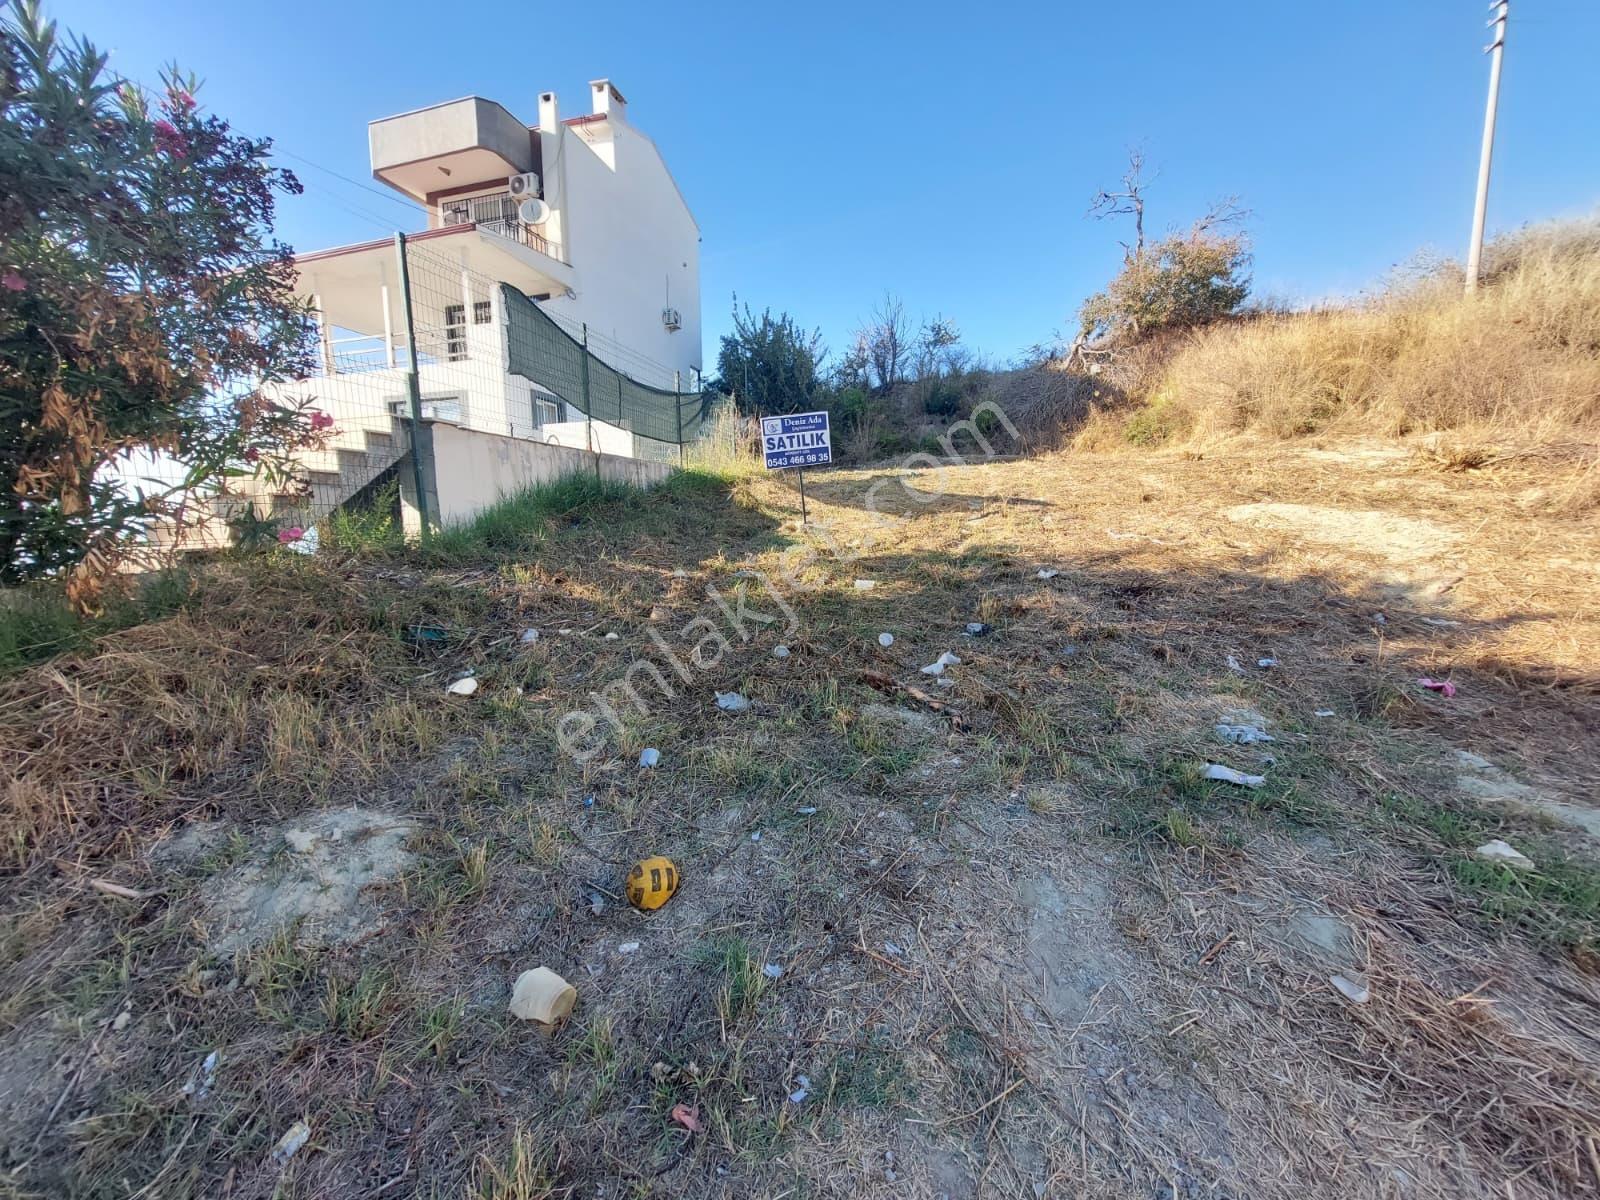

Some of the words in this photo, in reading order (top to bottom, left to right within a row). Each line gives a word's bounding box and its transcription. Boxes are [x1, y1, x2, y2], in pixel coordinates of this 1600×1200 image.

[784, 418, 806, 427] Deniz
[808, 415, 822, 424] Ada
[766, 432, 826, 450] SATILIK
[767, 457, 788, 467] 0543
[789, 455, 805, 465] 466
[806, 454, 817, 462] 98
[818, 453, 829, 461] 35
